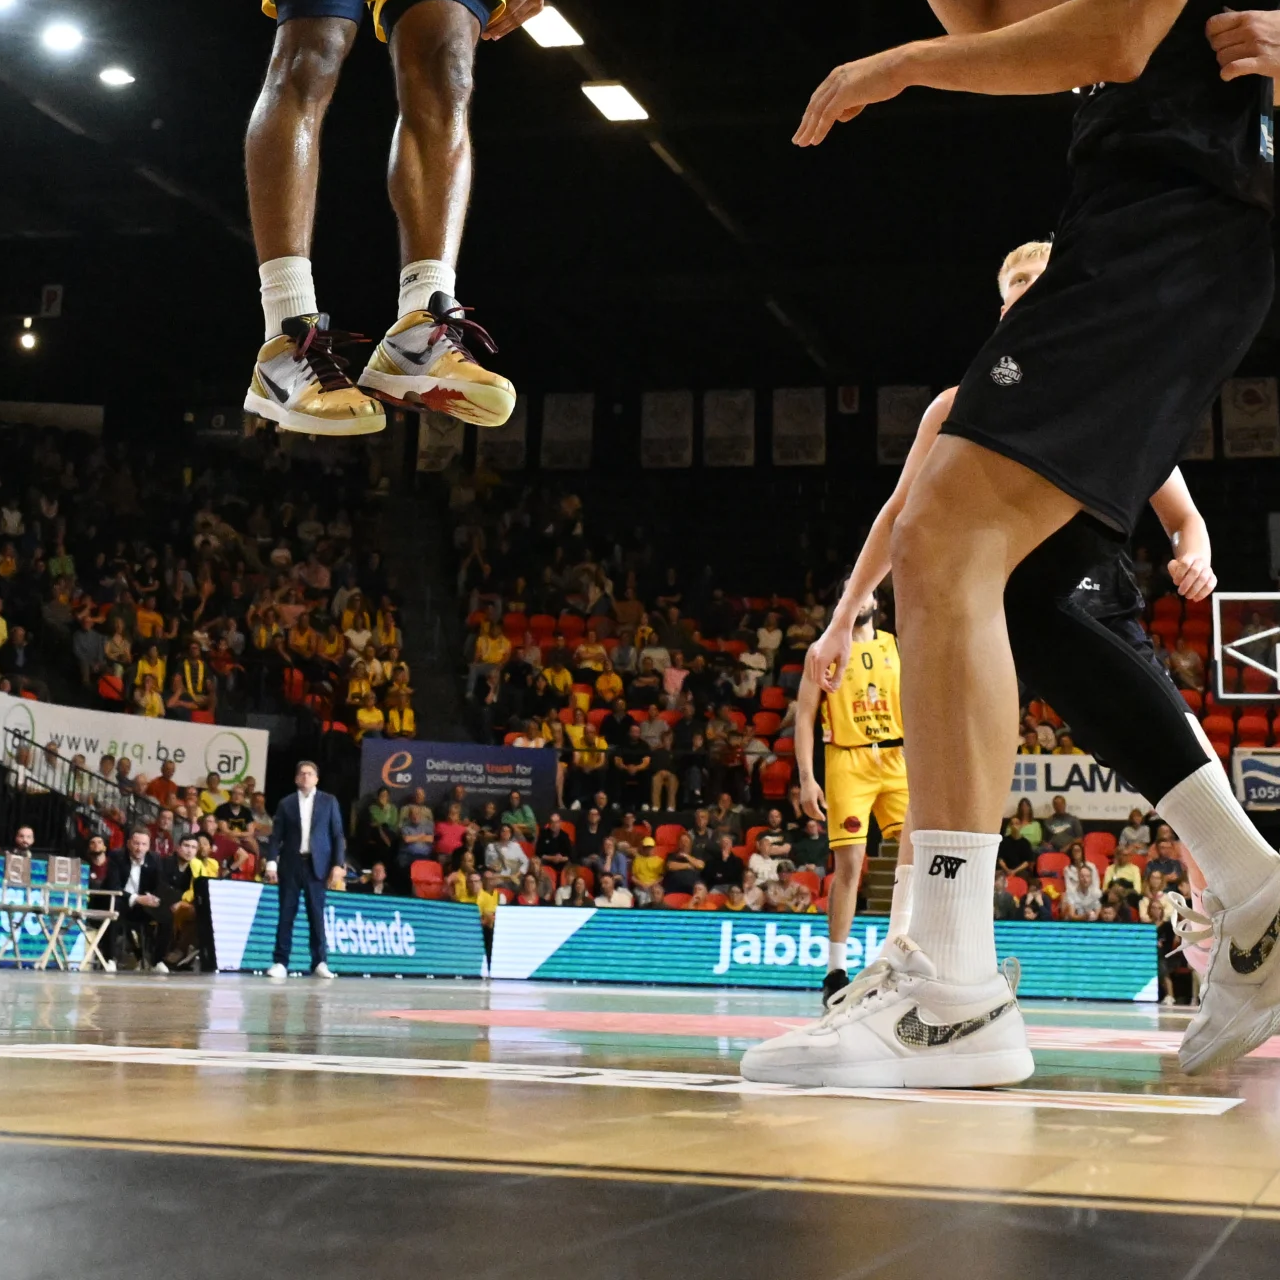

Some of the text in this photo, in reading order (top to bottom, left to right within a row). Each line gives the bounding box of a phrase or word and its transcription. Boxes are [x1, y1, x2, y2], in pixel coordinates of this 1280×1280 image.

[861, 651, 874, 670] 0
[49, 731, 187, 764] www.arq.be
[426, 759, 484, 774] Delivering
[515, 764, 533, 774] for
